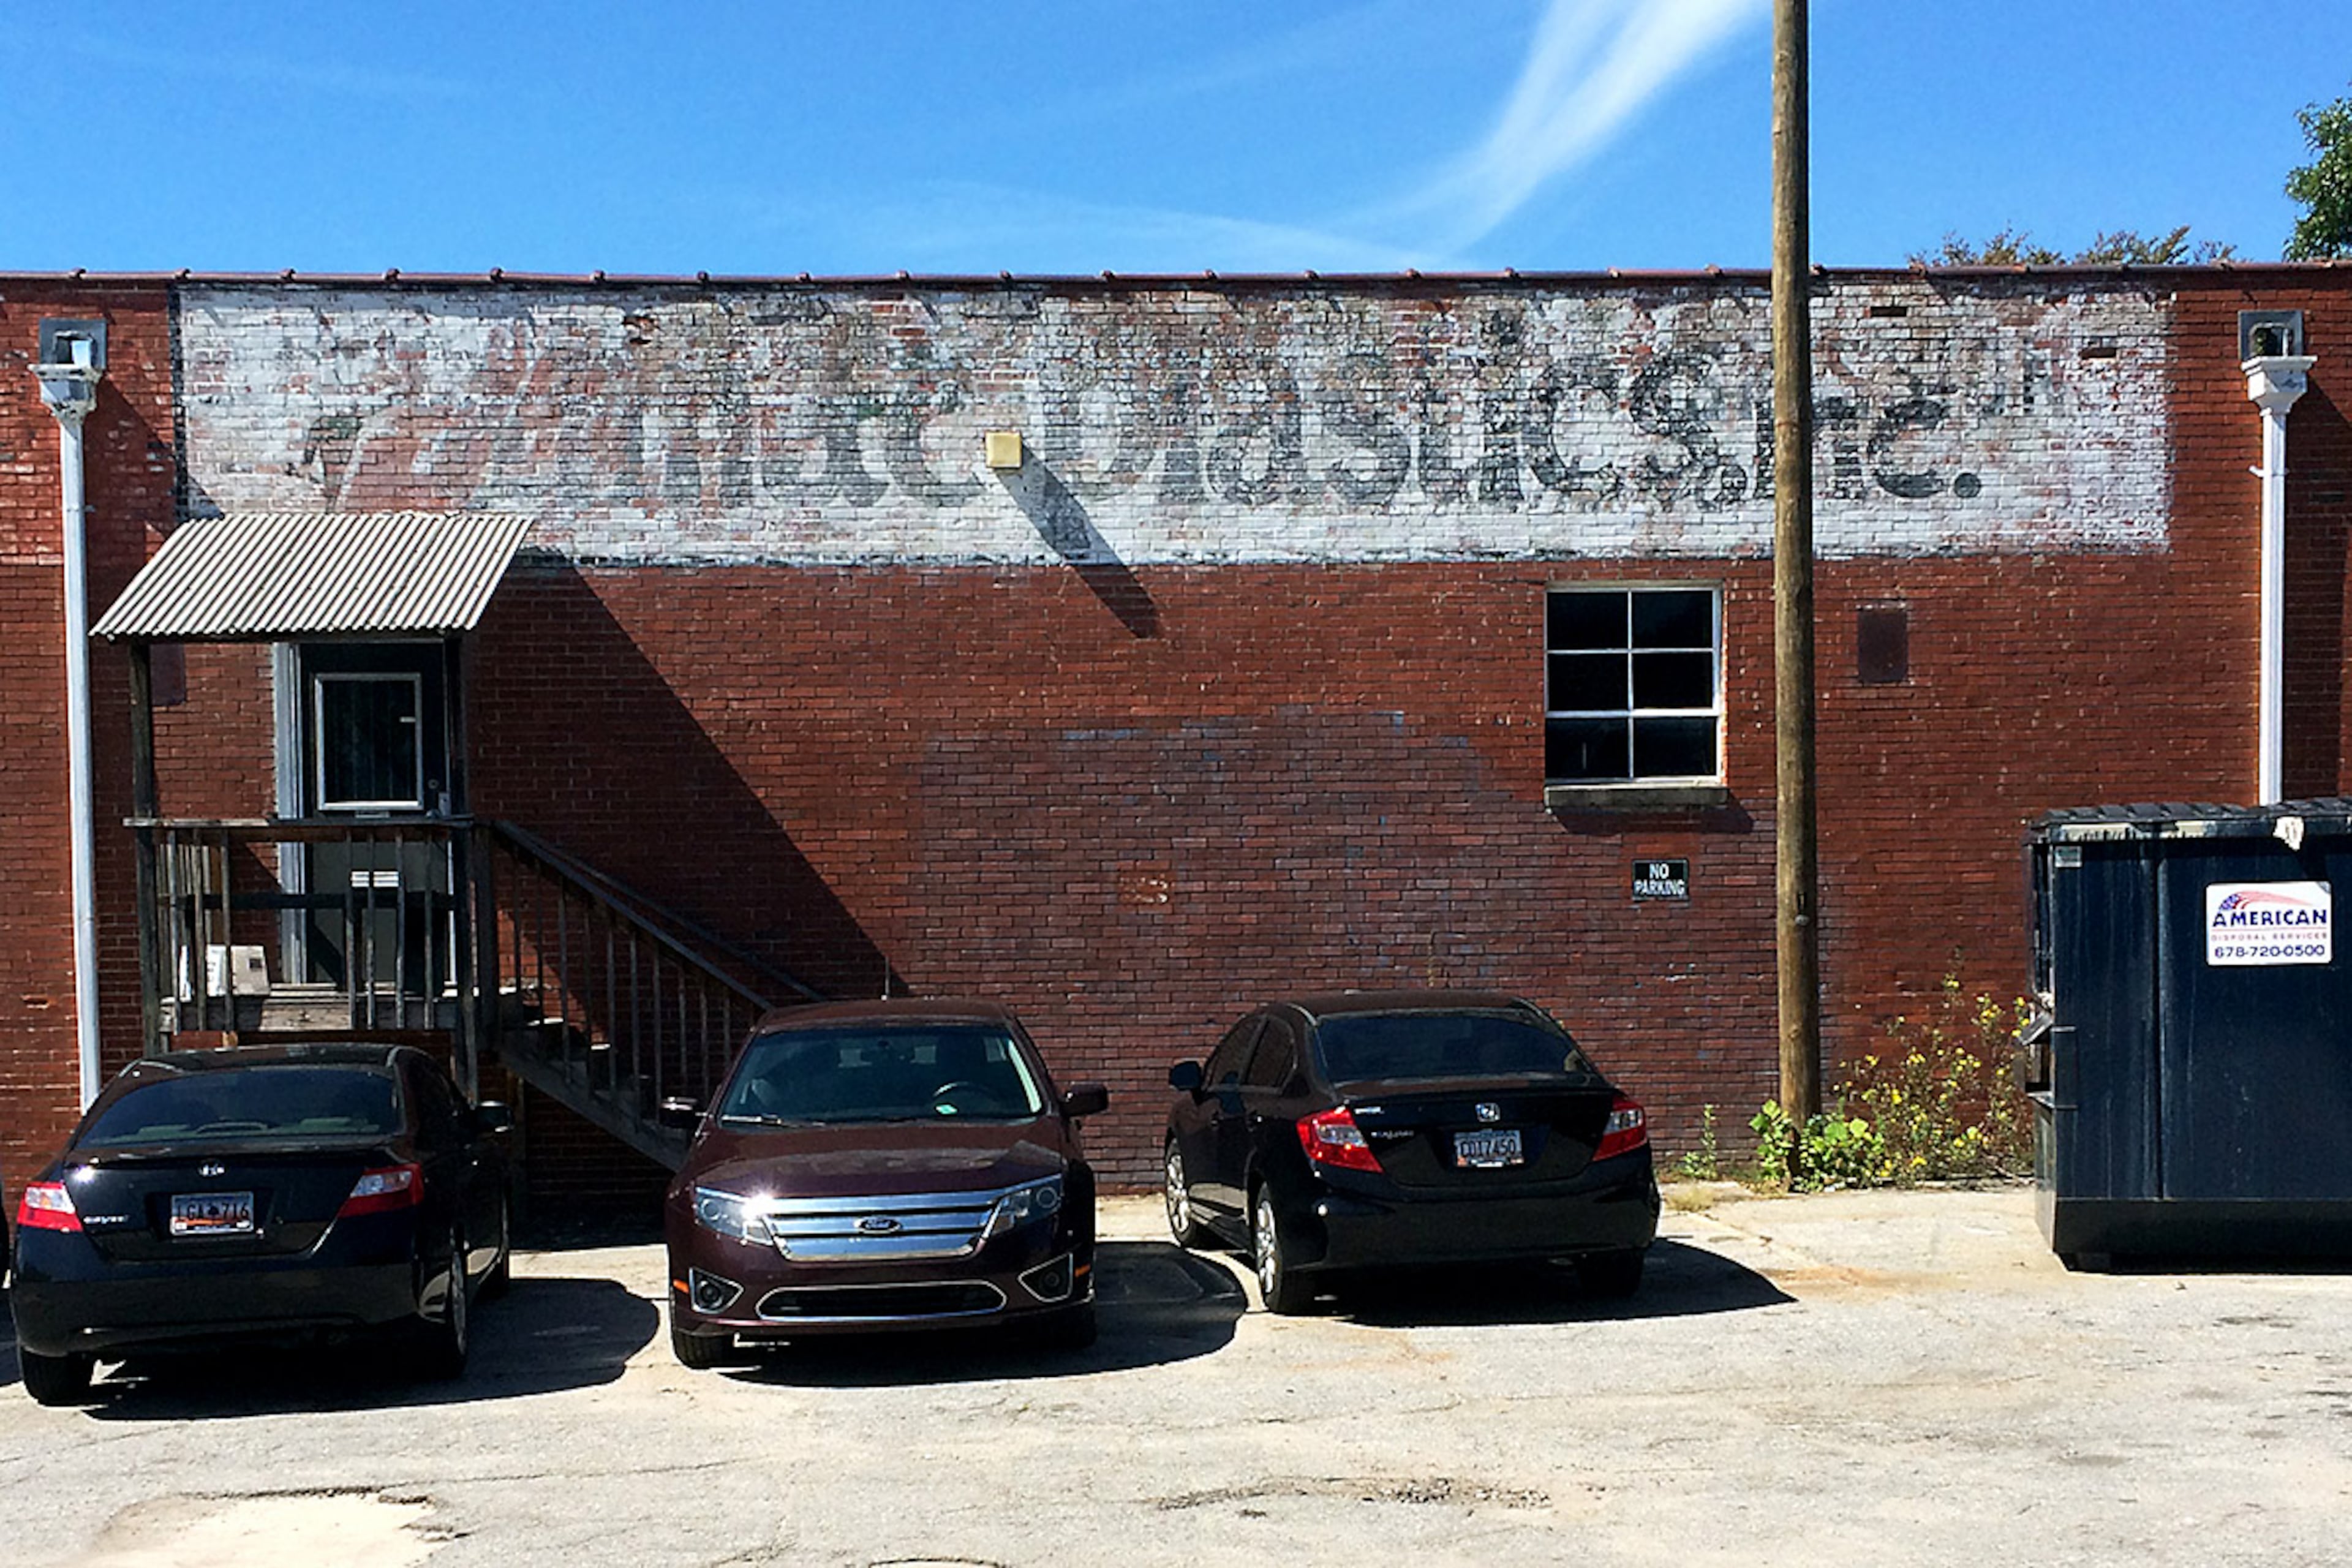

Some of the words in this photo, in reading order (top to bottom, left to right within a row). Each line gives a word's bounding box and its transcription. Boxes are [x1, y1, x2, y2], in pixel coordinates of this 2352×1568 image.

[1649, 864, 1670, 879] NO
[1634, 880, 1684, 895] PARKING
[2212, 910, 2327, 927] AMERICAN
[2214, 944, 2326, 959] 678-720-0500
